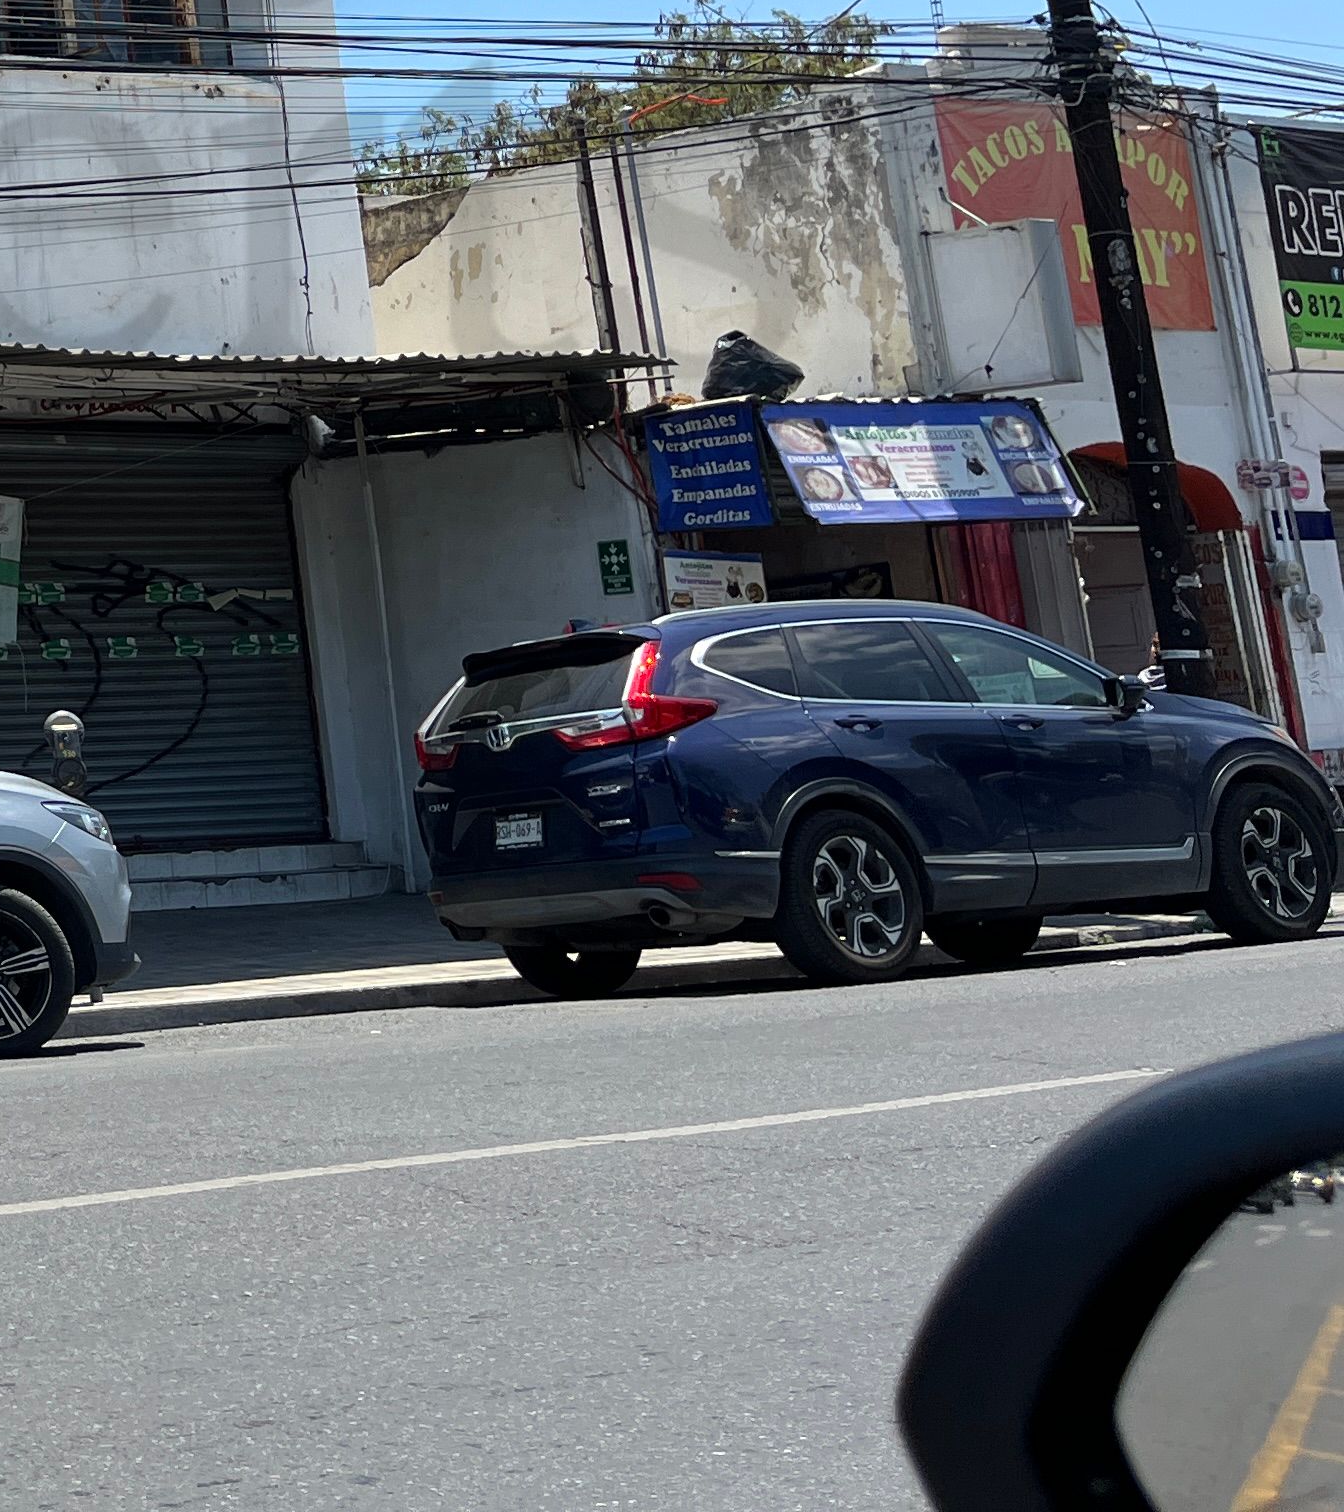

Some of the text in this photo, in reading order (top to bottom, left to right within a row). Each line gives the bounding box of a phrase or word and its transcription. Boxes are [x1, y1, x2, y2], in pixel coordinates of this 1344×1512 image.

[951, 120, 1045, 197] TACOS
[1114, 128, 1188, 212] POR
[1275, 185, 1344, 257] RE
[1308, 294, 1342, 318] 812
[659, 414, 736, 436] Tamales
[653, 432, 753, 453] Veracruzanos
[875, 443, 955, 454] Veracruzanos
[670, 459, 751, 479] Enchiladas
[672, 483, 756, 504] Empanadas
[684, 509, 750, 525] Gorditas
